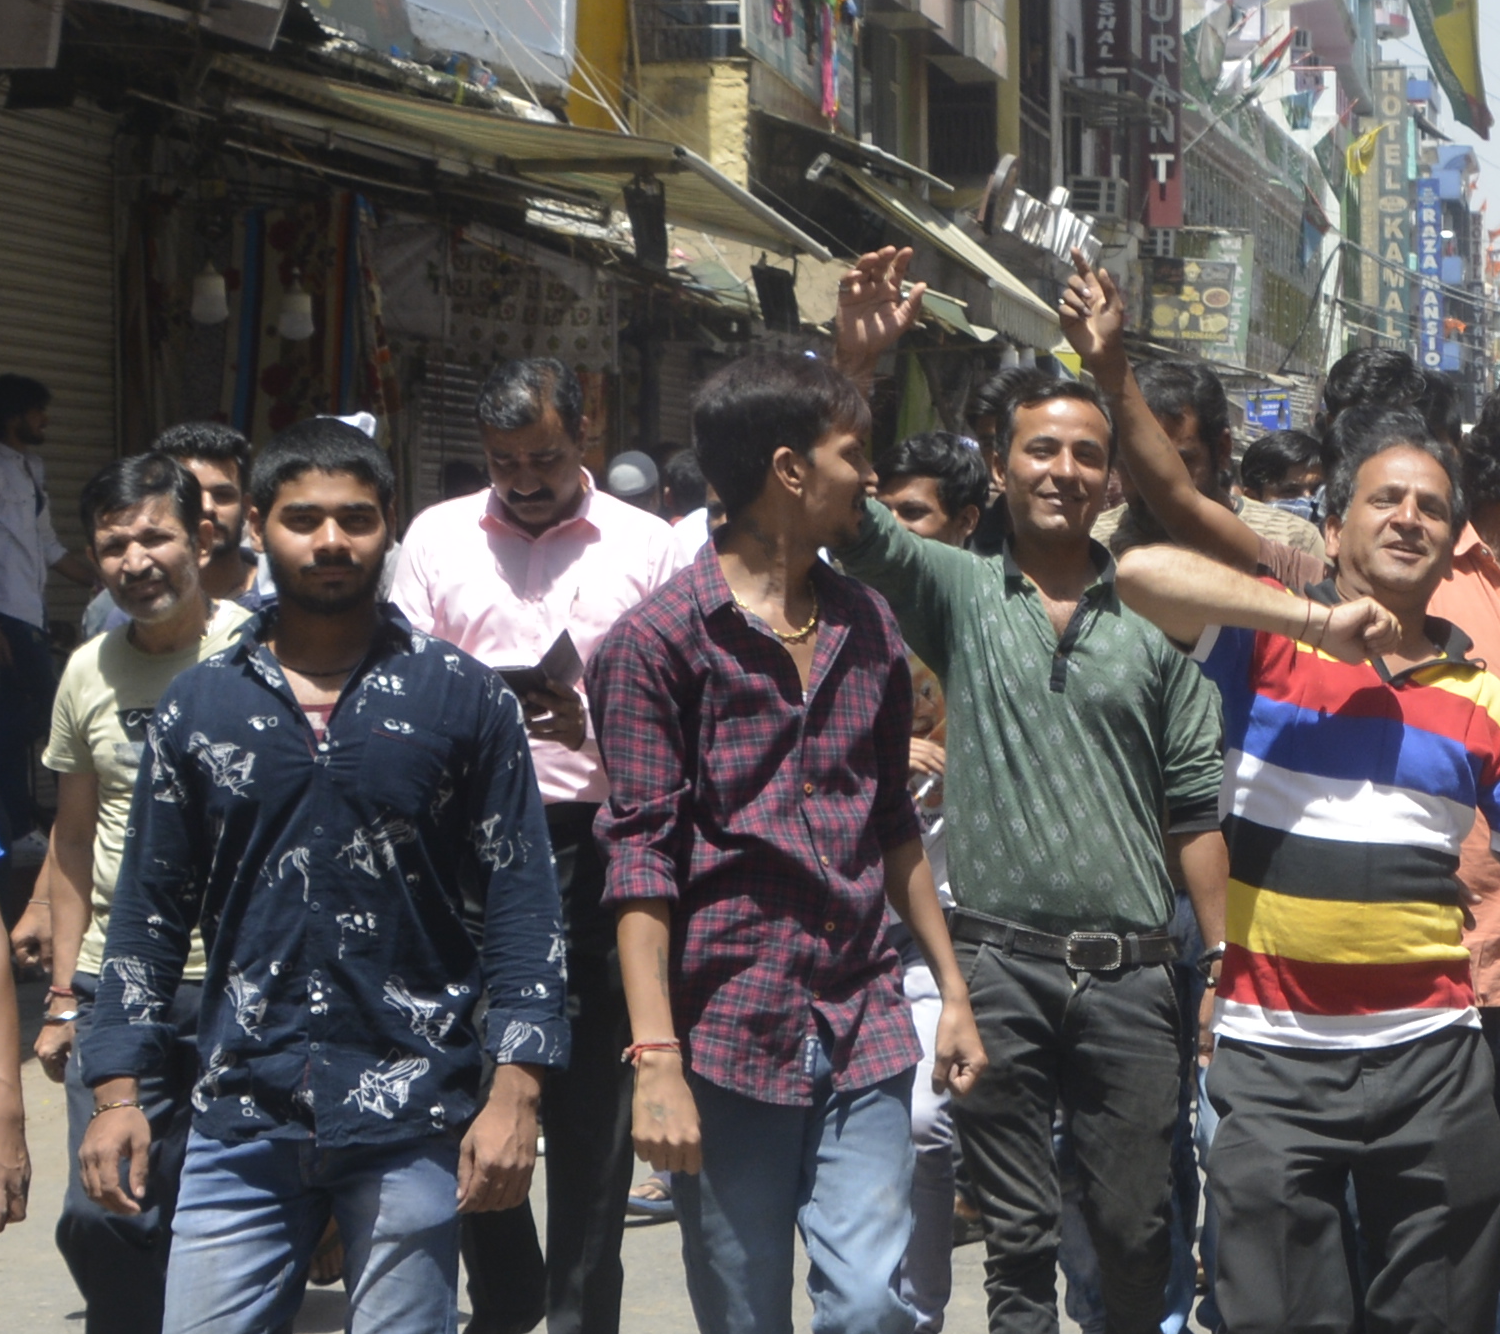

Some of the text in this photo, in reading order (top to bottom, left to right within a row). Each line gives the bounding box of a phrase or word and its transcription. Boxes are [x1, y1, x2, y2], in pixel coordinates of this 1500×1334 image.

[1382, 69, 1402, 191] HOTEL
[1382, 218, 1406, 339] KAMAL
[1422, 208, 1439, 270] RAZA
